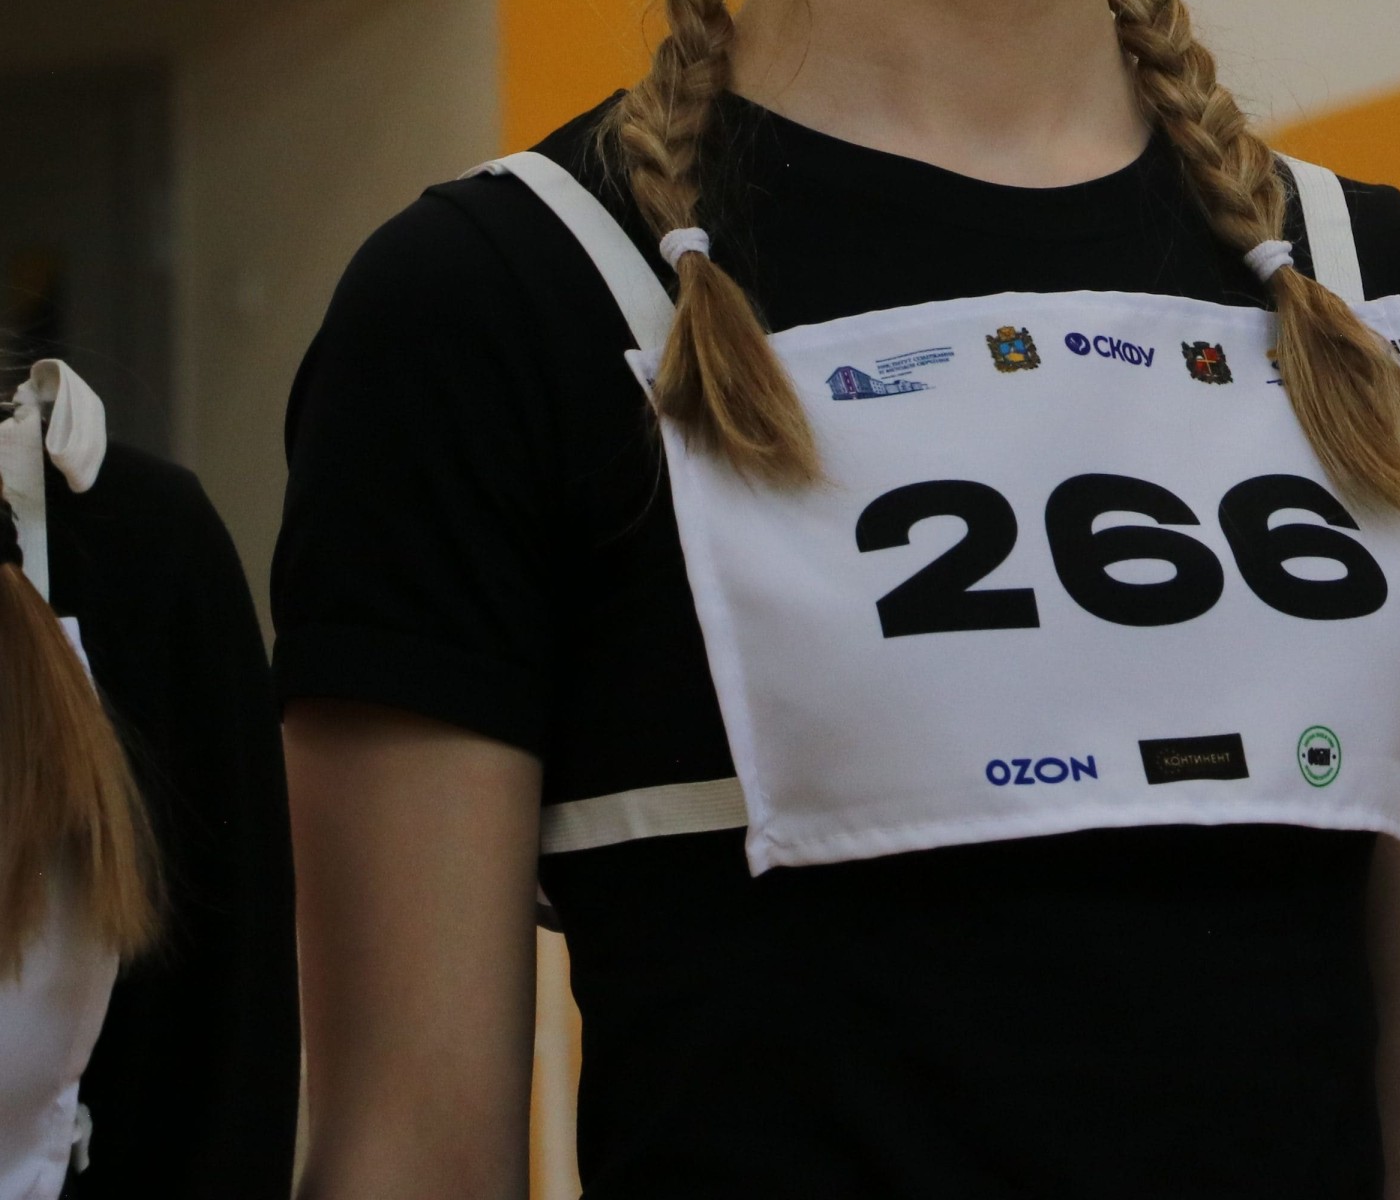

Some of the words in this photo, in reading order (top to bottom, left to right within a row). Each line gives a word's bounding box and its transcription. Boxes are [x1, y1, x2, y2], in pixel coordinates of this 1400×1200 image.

[1092, 335, 1155, 368] СКФУ
[855, 473, 1389, 639] 266
[986, 756, 1098, 788] OZON
[1163, 752, 1231, 767] КОНТИНЕНТ
